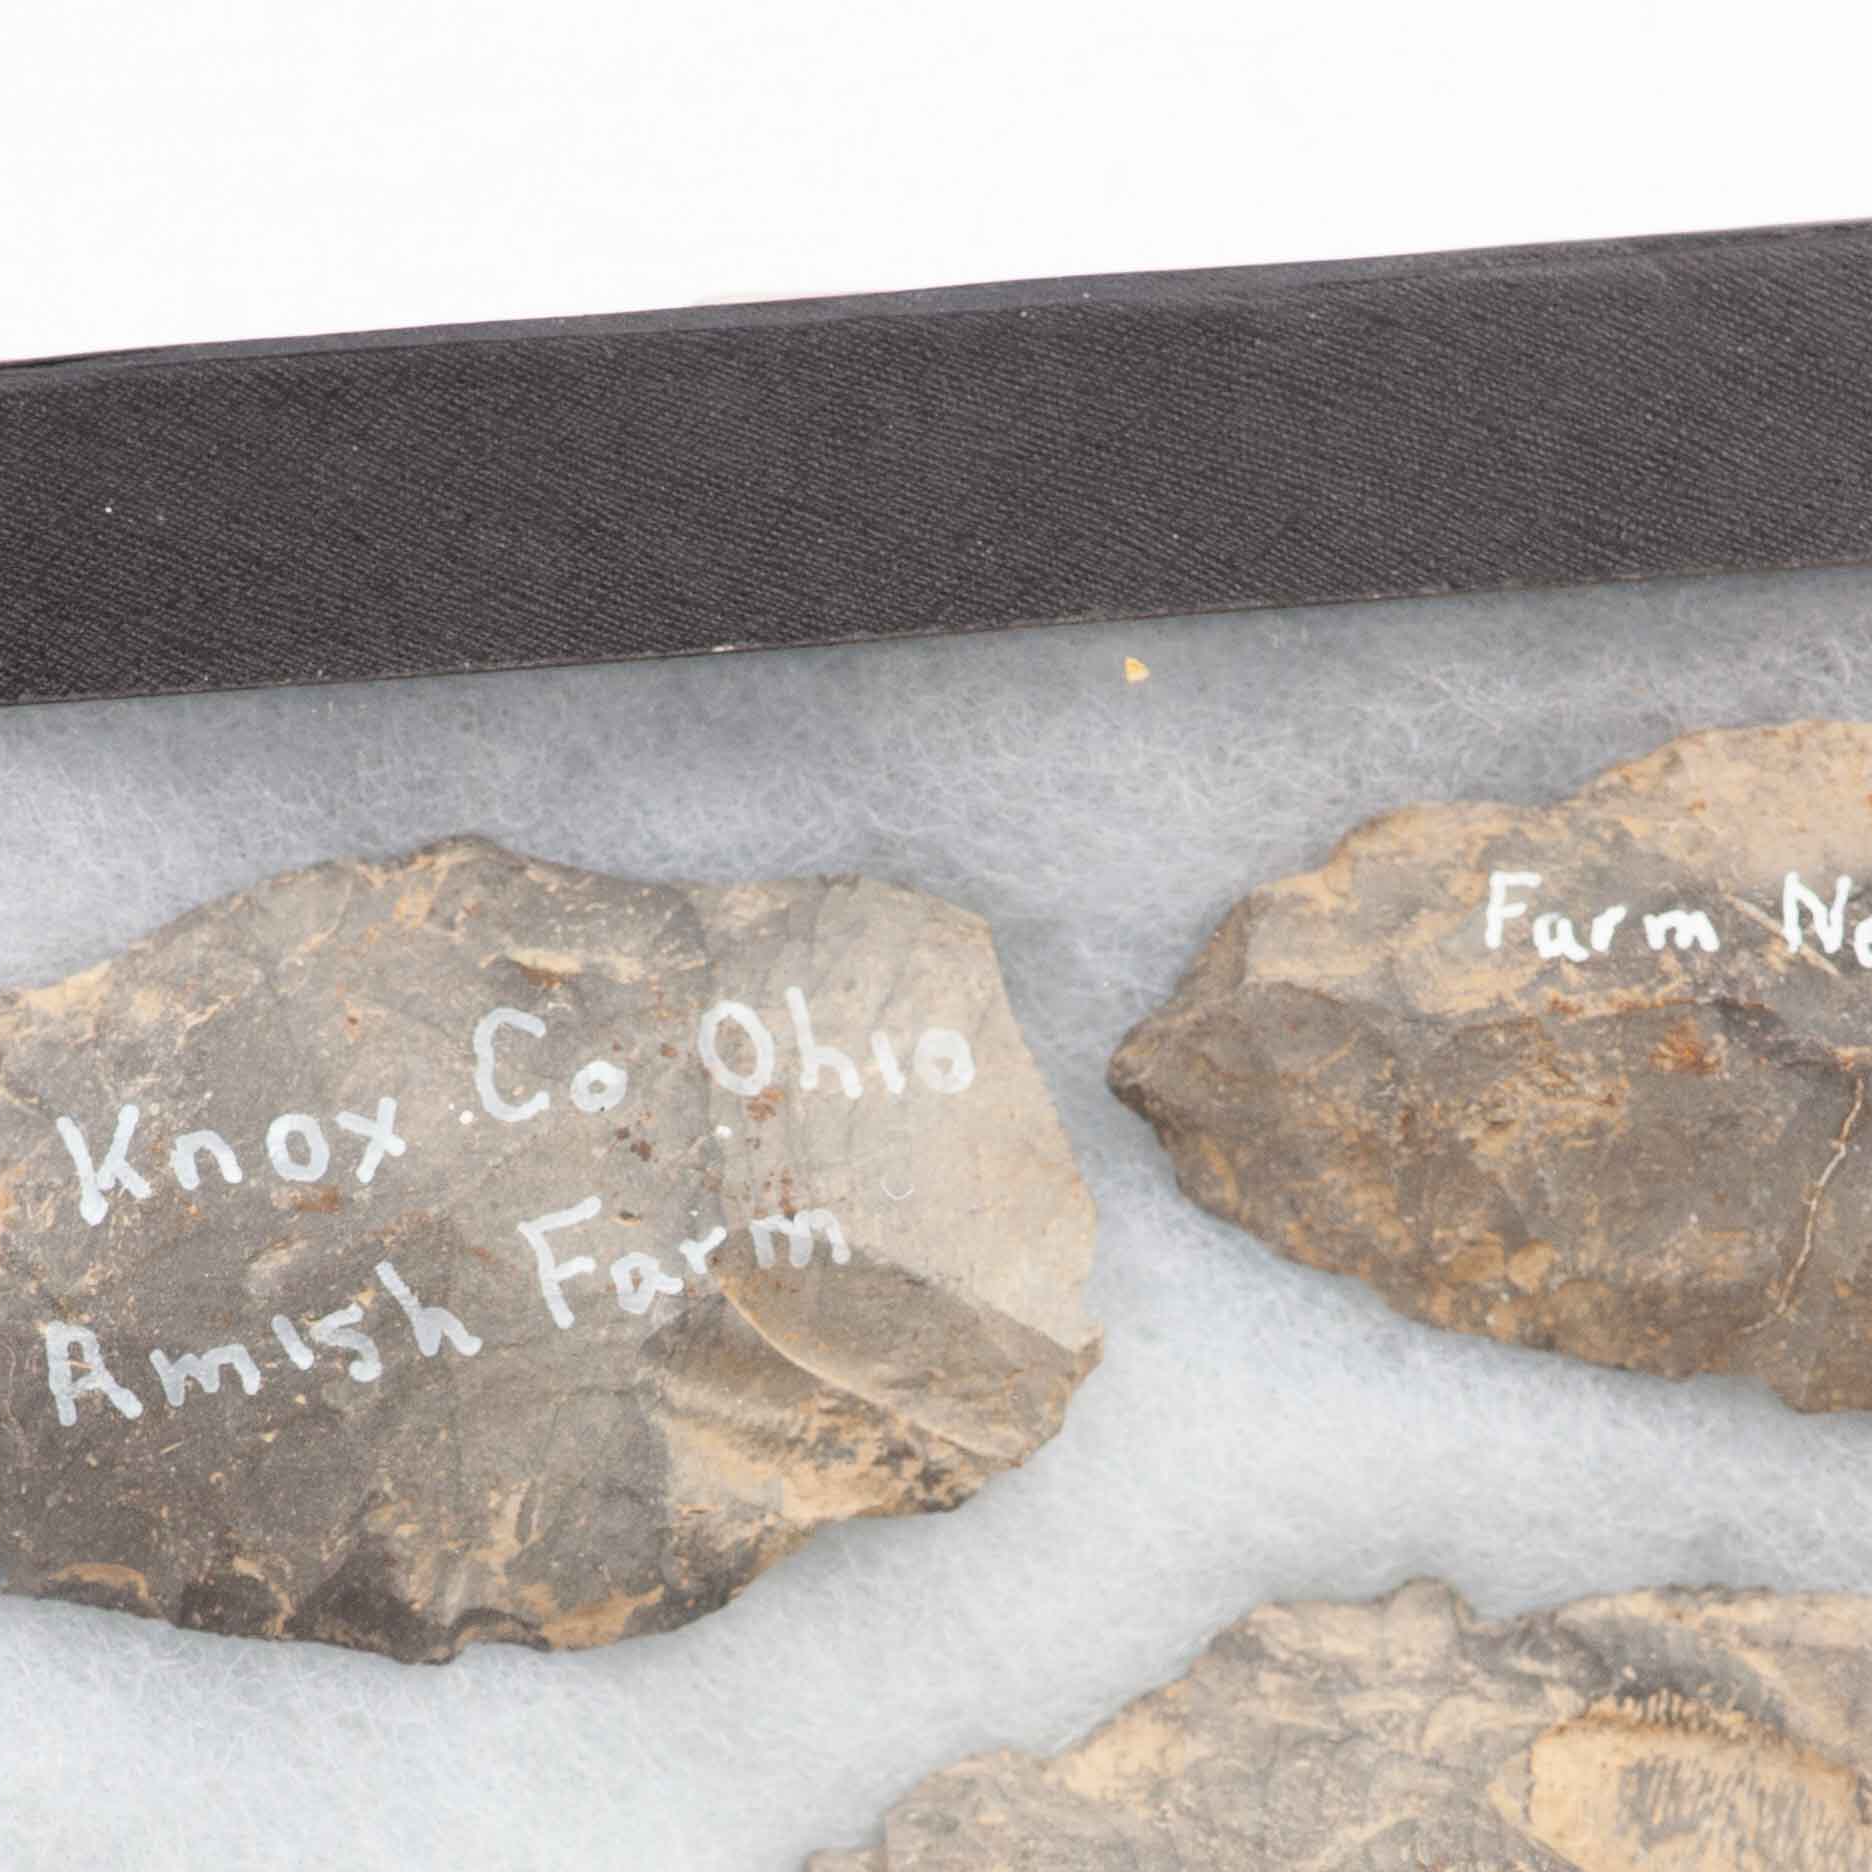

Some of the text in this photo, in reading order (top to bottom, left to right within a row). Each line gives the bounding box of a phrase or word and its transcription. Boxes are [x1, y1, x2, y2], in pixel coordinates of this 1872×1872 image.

[1483, 870, 1720, 964] Farm
[56, 987, 974, 1225] Knox Co Ohio
[42, 1196, 851, 1425] Amish Farm
